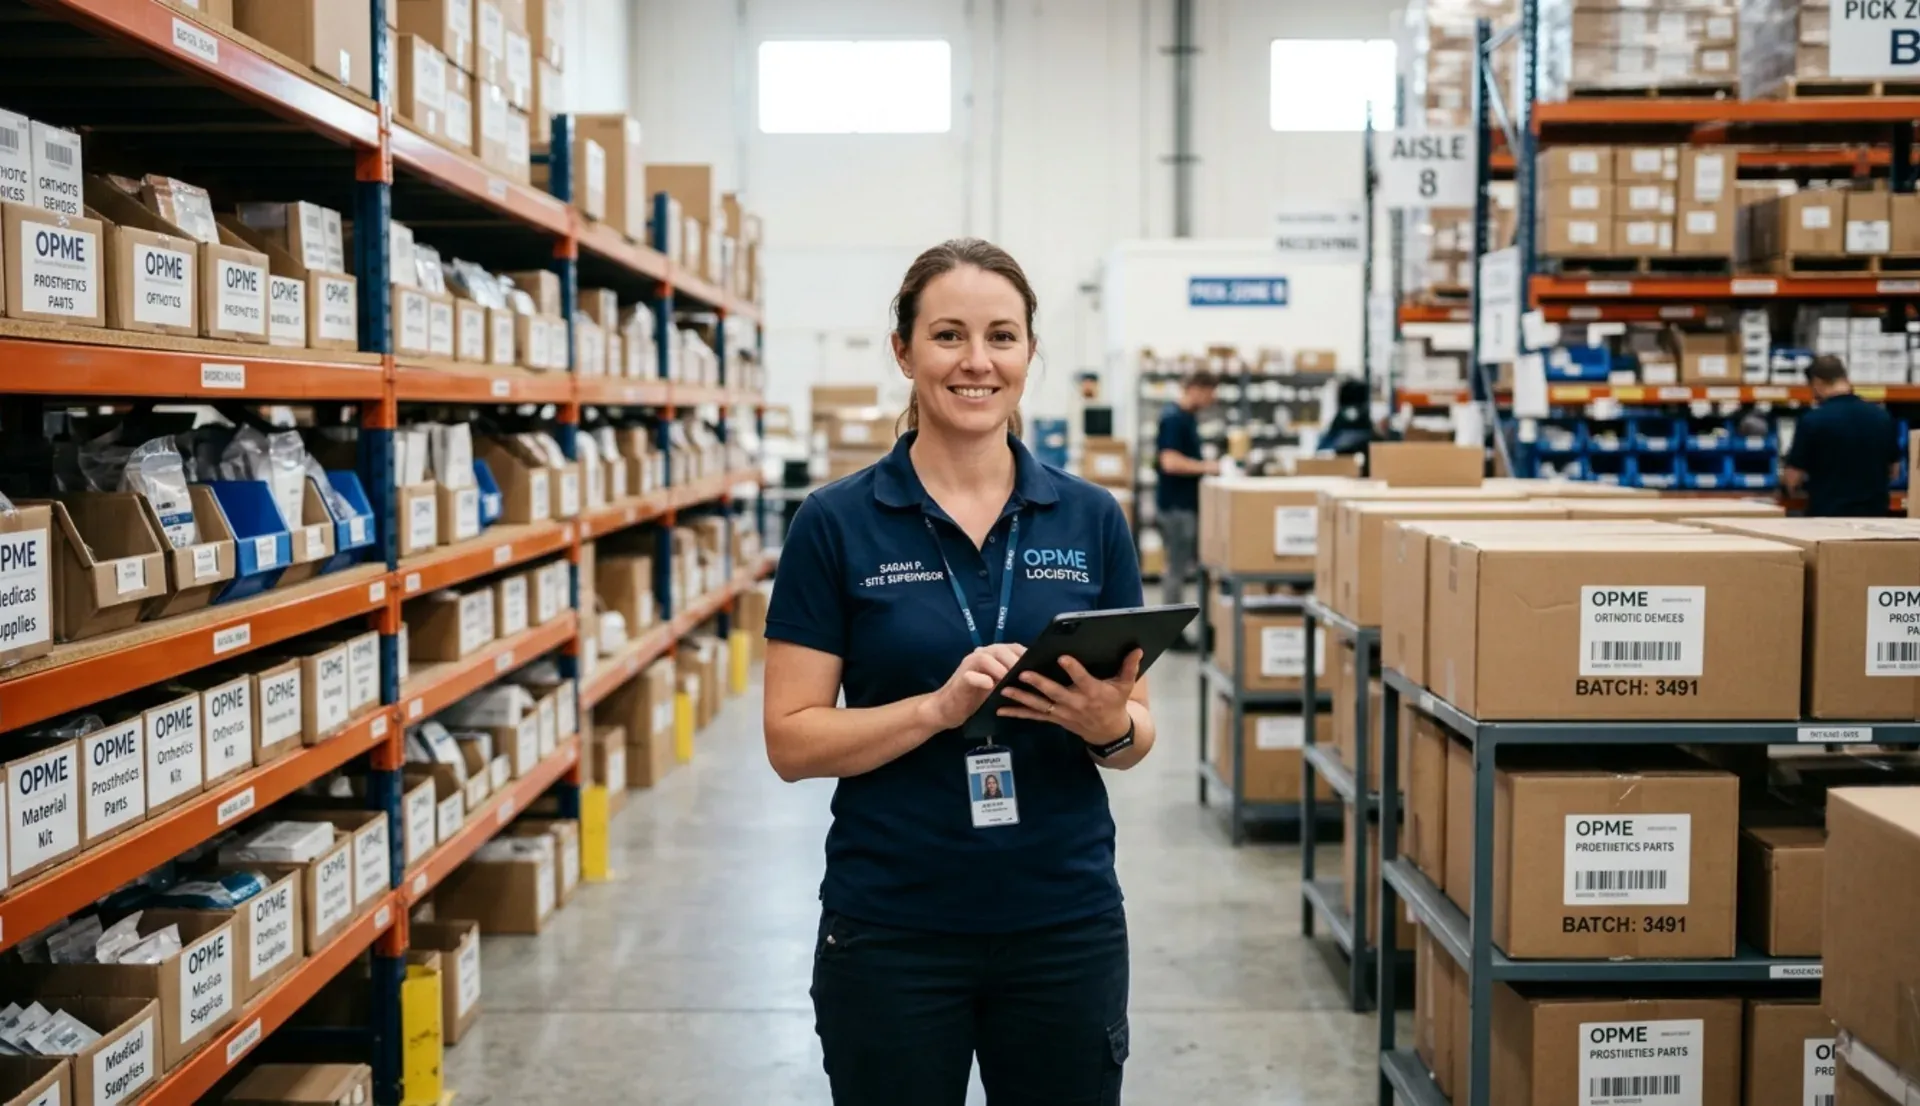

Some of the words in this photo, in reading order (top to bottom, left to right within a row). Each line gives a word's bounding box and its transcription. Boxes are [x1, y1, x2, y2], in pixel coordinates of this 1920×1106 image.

[1846, 0, 1896, 19] PICK
[1904, 0, 1920, 19] Z
[1890, 29, 1920, 64] B
[1392, 136, 1466, 160] AISLE
[1419, 169, 1438, 198] 8
[36, 231, 85, 262] OPME
[146, 252, 182, 280] OPME
[880, 562, 912, 573] SARAH
[1024, 548, 1088, 570] OPME
[0, 585, 36, 608] edicas
[1592, 591, 1648, 606] OPME
[1576, 680, 1648, 696] BATCH:
[1656, 680, 1698, 696] 3491
[156, 706, 193, 739] OPME
[94, 730, 136, 766] OPME
[20, 755, 68, 795] OPME
[22, 793, 66, 827] Material
[1576, 820, 1634, 836] OPME
[1643, 842, 1674, 852] PARTS
[1563, 917, 1636, 932] BATCH:
[1644, 916, 1686, 932] 3491
[1590, 1026, 1648, 1044] OPME
[1658, 1047, 1688, 1058] PARTS
